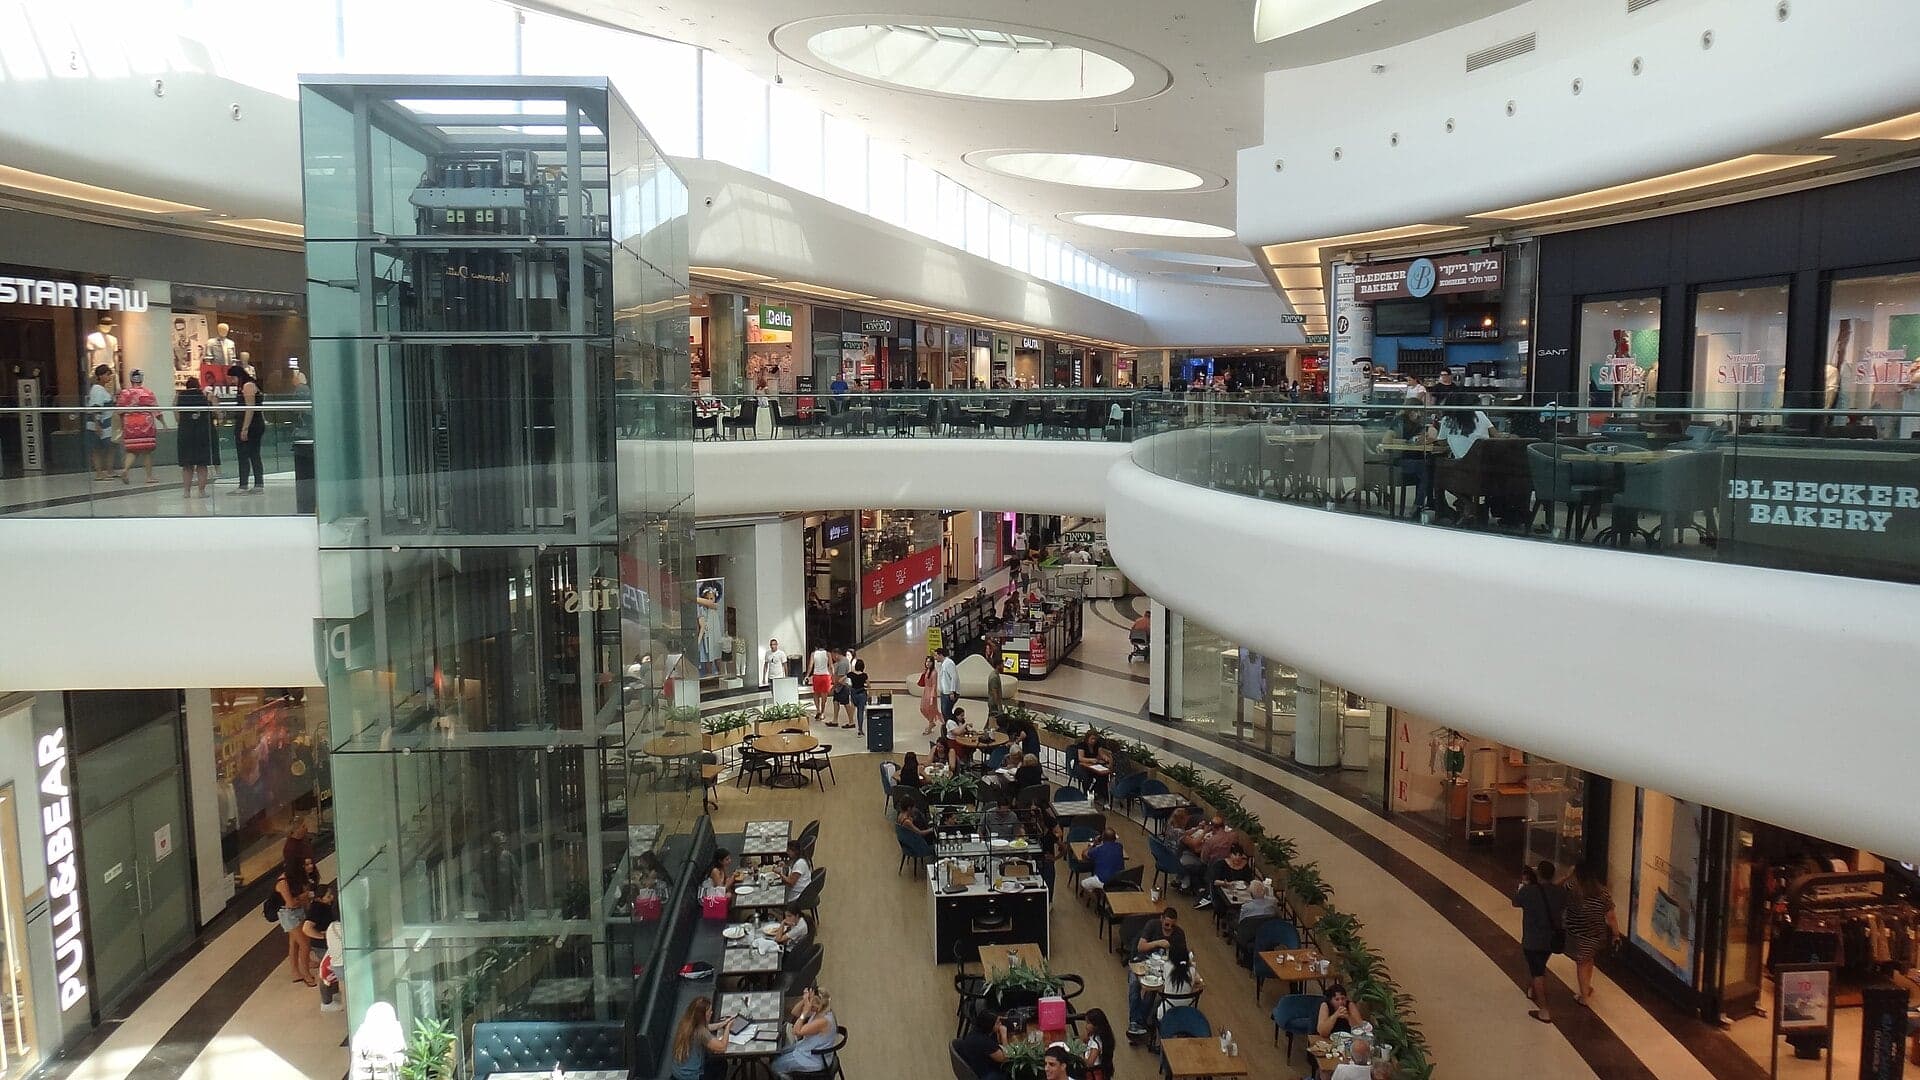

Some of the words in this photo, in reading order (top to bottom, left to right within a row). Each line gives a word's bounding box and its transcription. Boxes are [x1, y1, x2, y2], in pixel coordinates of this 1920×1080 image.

[1355, 270, 1407, 284] BLEECKER
[1469, 259, 1498, 273] בליקר
[0, 276, 79, 308] STAR
[81, 284, 148, 312] RAW
[1361, 282, 1399, 294] BAKERY
[1537, 348, 1568, 357] GANT
[1717, 363, 1766, 385] SALE
[1855, 361, 1912, 385] SALE
[1728, 480, 1920, 509] BLEECKER
[1750, 504, 1893, 532] BAKERY
[1065, 573, 1094, 585] rebar
[913, 578, 933, 610] TFS
[38, 726, 87, 1012] PULL&BEAR
